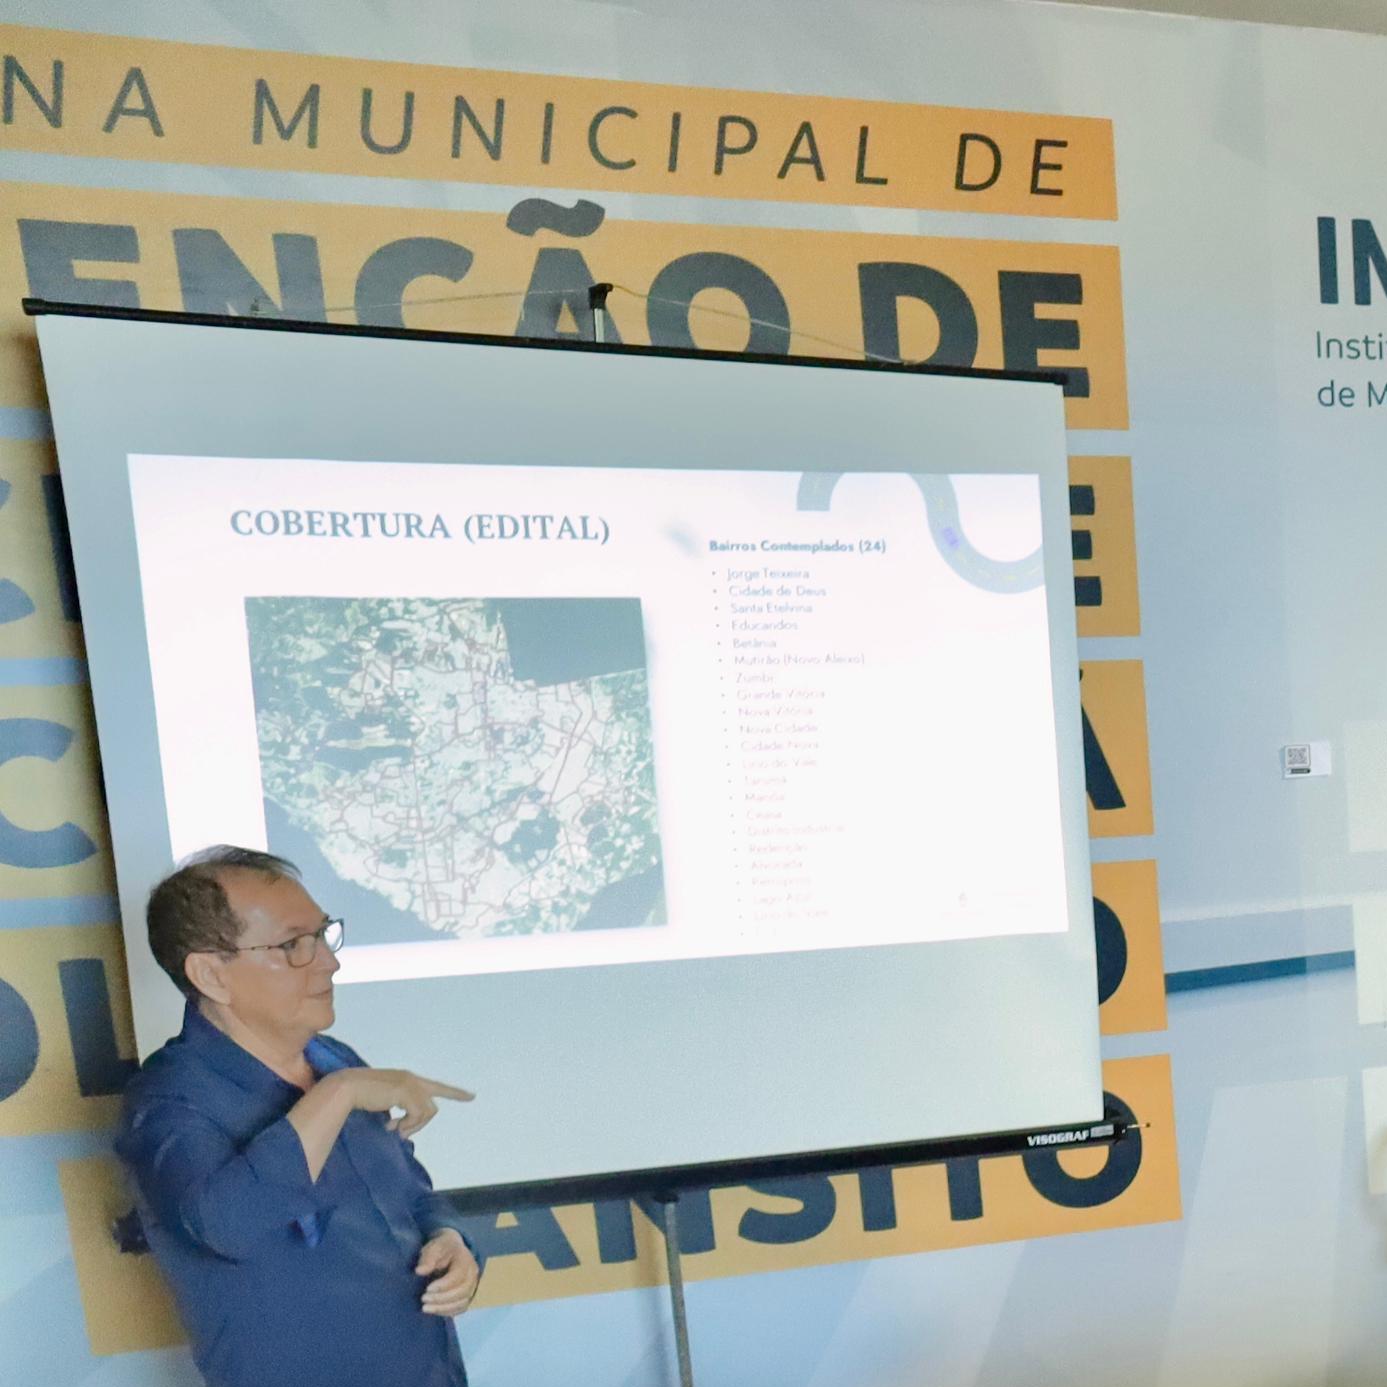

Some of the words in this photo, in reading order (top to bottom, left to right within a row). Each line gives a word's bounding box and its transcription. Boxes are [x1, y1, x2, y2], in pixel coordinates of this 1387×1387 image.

[251, 77, 889, 186] MUNICIPAL
[954, 132, 1069, 197] DE
[857, 261, 1091, 398] DE
[1317, 380, 1356, 408] de
[230, 509, 452, 539] COBERTURA
[463, 513, 611, 545] (EDITAL)
[709, 540, 756, 552] Bairros
[760, 540, 854, 555] Contemplados
[858, 540, 886, 554] (24)
[727, 567, 760, 581] Jorge
[728, 584, 773, 597] Cidade
[776, 584, 792, 597] de
[796, 585, 827, 597] Deus
[1026, 1129, 1090, 1147] VISOGRAF
